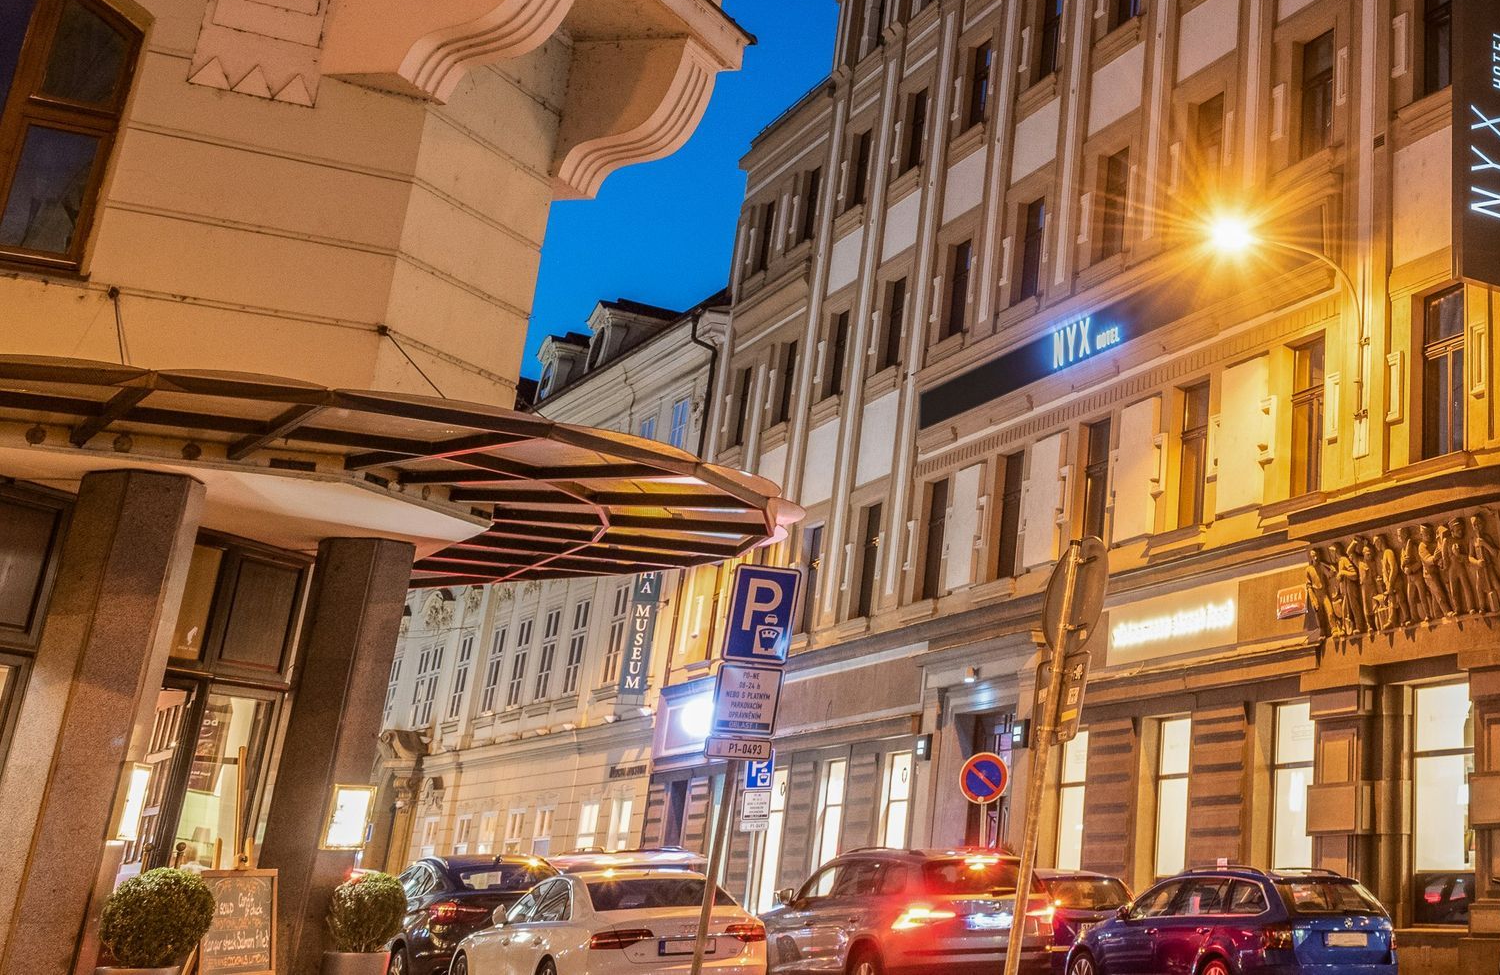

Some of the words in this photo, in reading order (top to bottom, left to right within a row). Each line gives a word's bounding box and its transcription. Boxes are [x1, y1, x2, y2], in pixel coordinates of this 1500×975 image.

[1052, 316, 1092, 369] NYX
[741, 577, 783, 631] P
[624, 604, 651, 689] MUSEUM
[728, 743, 762, 755] P1-0493
